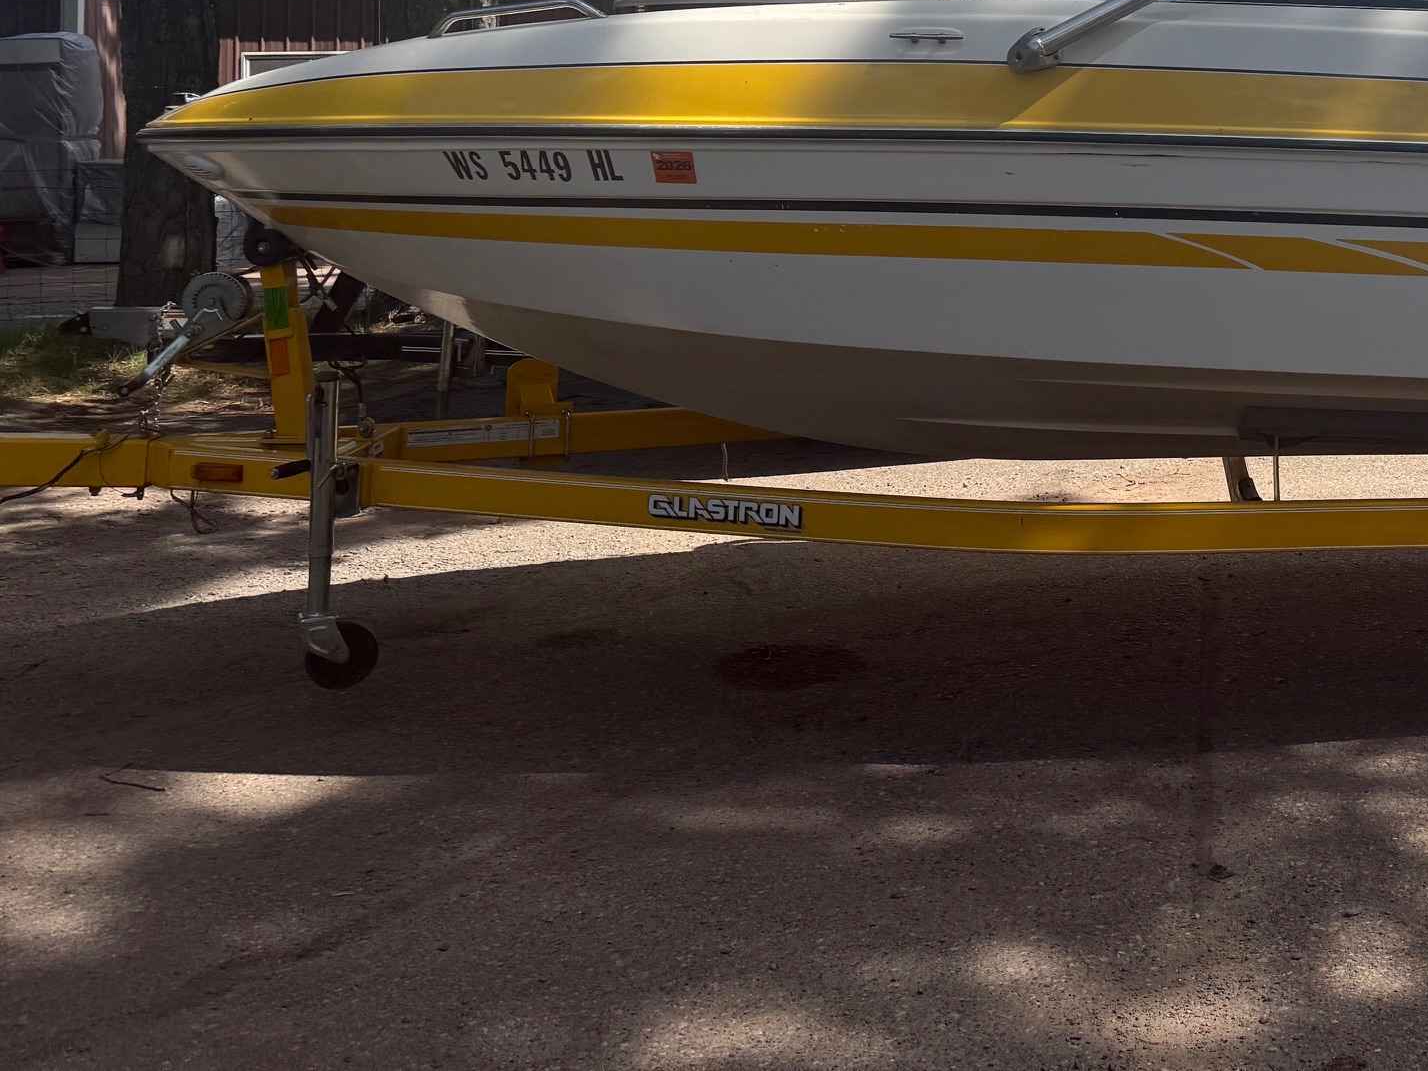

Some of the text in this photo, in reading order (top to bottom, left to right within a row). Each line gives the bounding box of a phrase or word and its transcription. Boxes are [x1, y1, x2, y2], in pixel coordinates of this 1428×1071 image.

[443, 149, 624, 182] WS 5449 HL
[648, 495, 802, 528] GLASTRON
